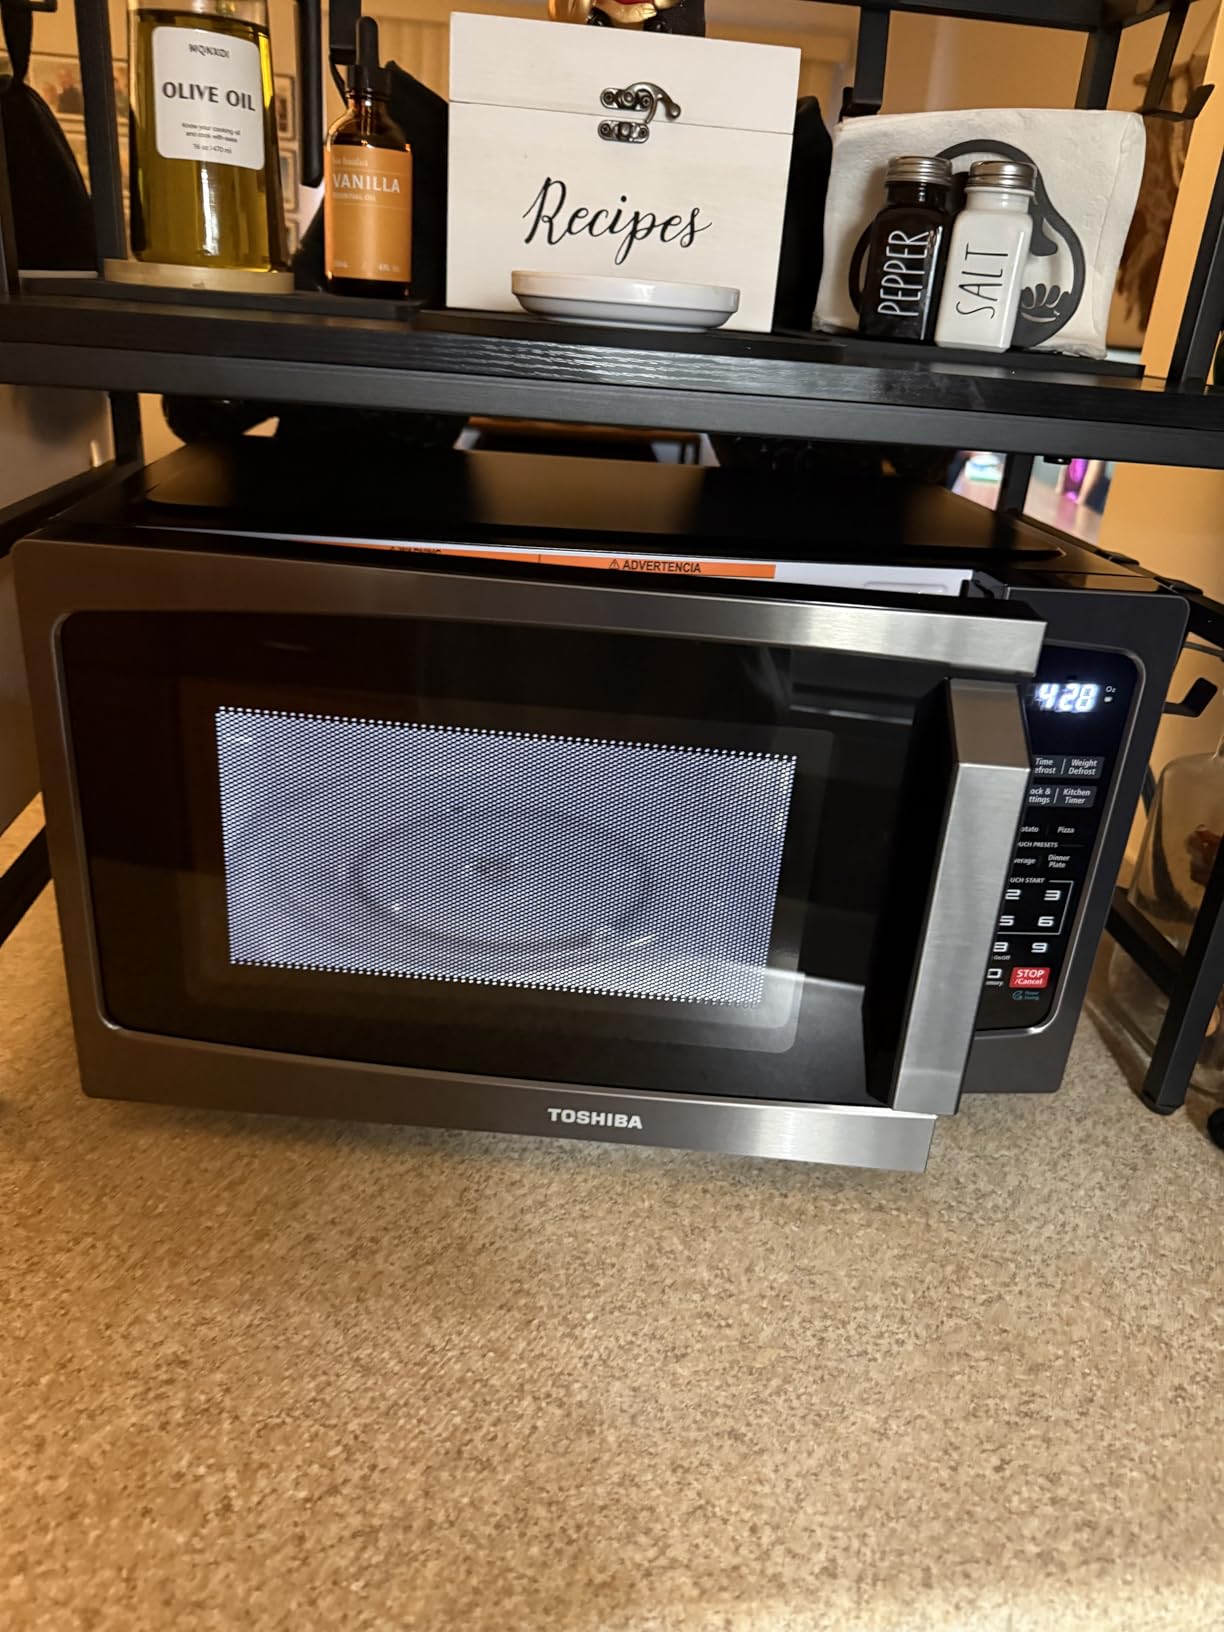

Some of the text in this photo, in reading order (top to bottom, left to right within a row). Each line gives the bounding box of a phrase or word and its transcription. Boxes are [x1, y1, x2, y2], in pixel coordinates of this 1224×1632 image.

[163, 81, 256, 111] OLIVE OIL
[333, 173, 400, 193] VANILLA
[522, 177, 713, 265] Recipes
[877, 230, 930, 317] PEPPER
[956, 243, 1009, 319] SALT
[622, 559, 701, 574] ADVERTENCIA
[1035, 757, 1054, 766] Time
[1071, 758, 1098, 769] Weight
[1034, 766, 1057, 774] efrost
[1068, 767, 1096, 775] Defrost
[1030, 787, 1051, 795] ock &
[1063, 787, 1091, 796] Kitchen
[1029, 796, 1051, 805] ttings
[1064, 796, 1086, 804] Timer
[1057, 826, 1076, 834] Pizza
[1048, 854, 1071, 862] Dinner
[1005, 889, 1022, 900] 2
[1043, 890, 1061, 901] 3
[999, 915, 1015, 926] 5
[1038, 916, 1055, 927] 6
[1031, 942, 1049, 953] 9
[1016, 969, 1045, 979] STOP
[1014, 978, 1044, 986] /Cancel
[547, 1108, 643, 1129] TOSHIBA
